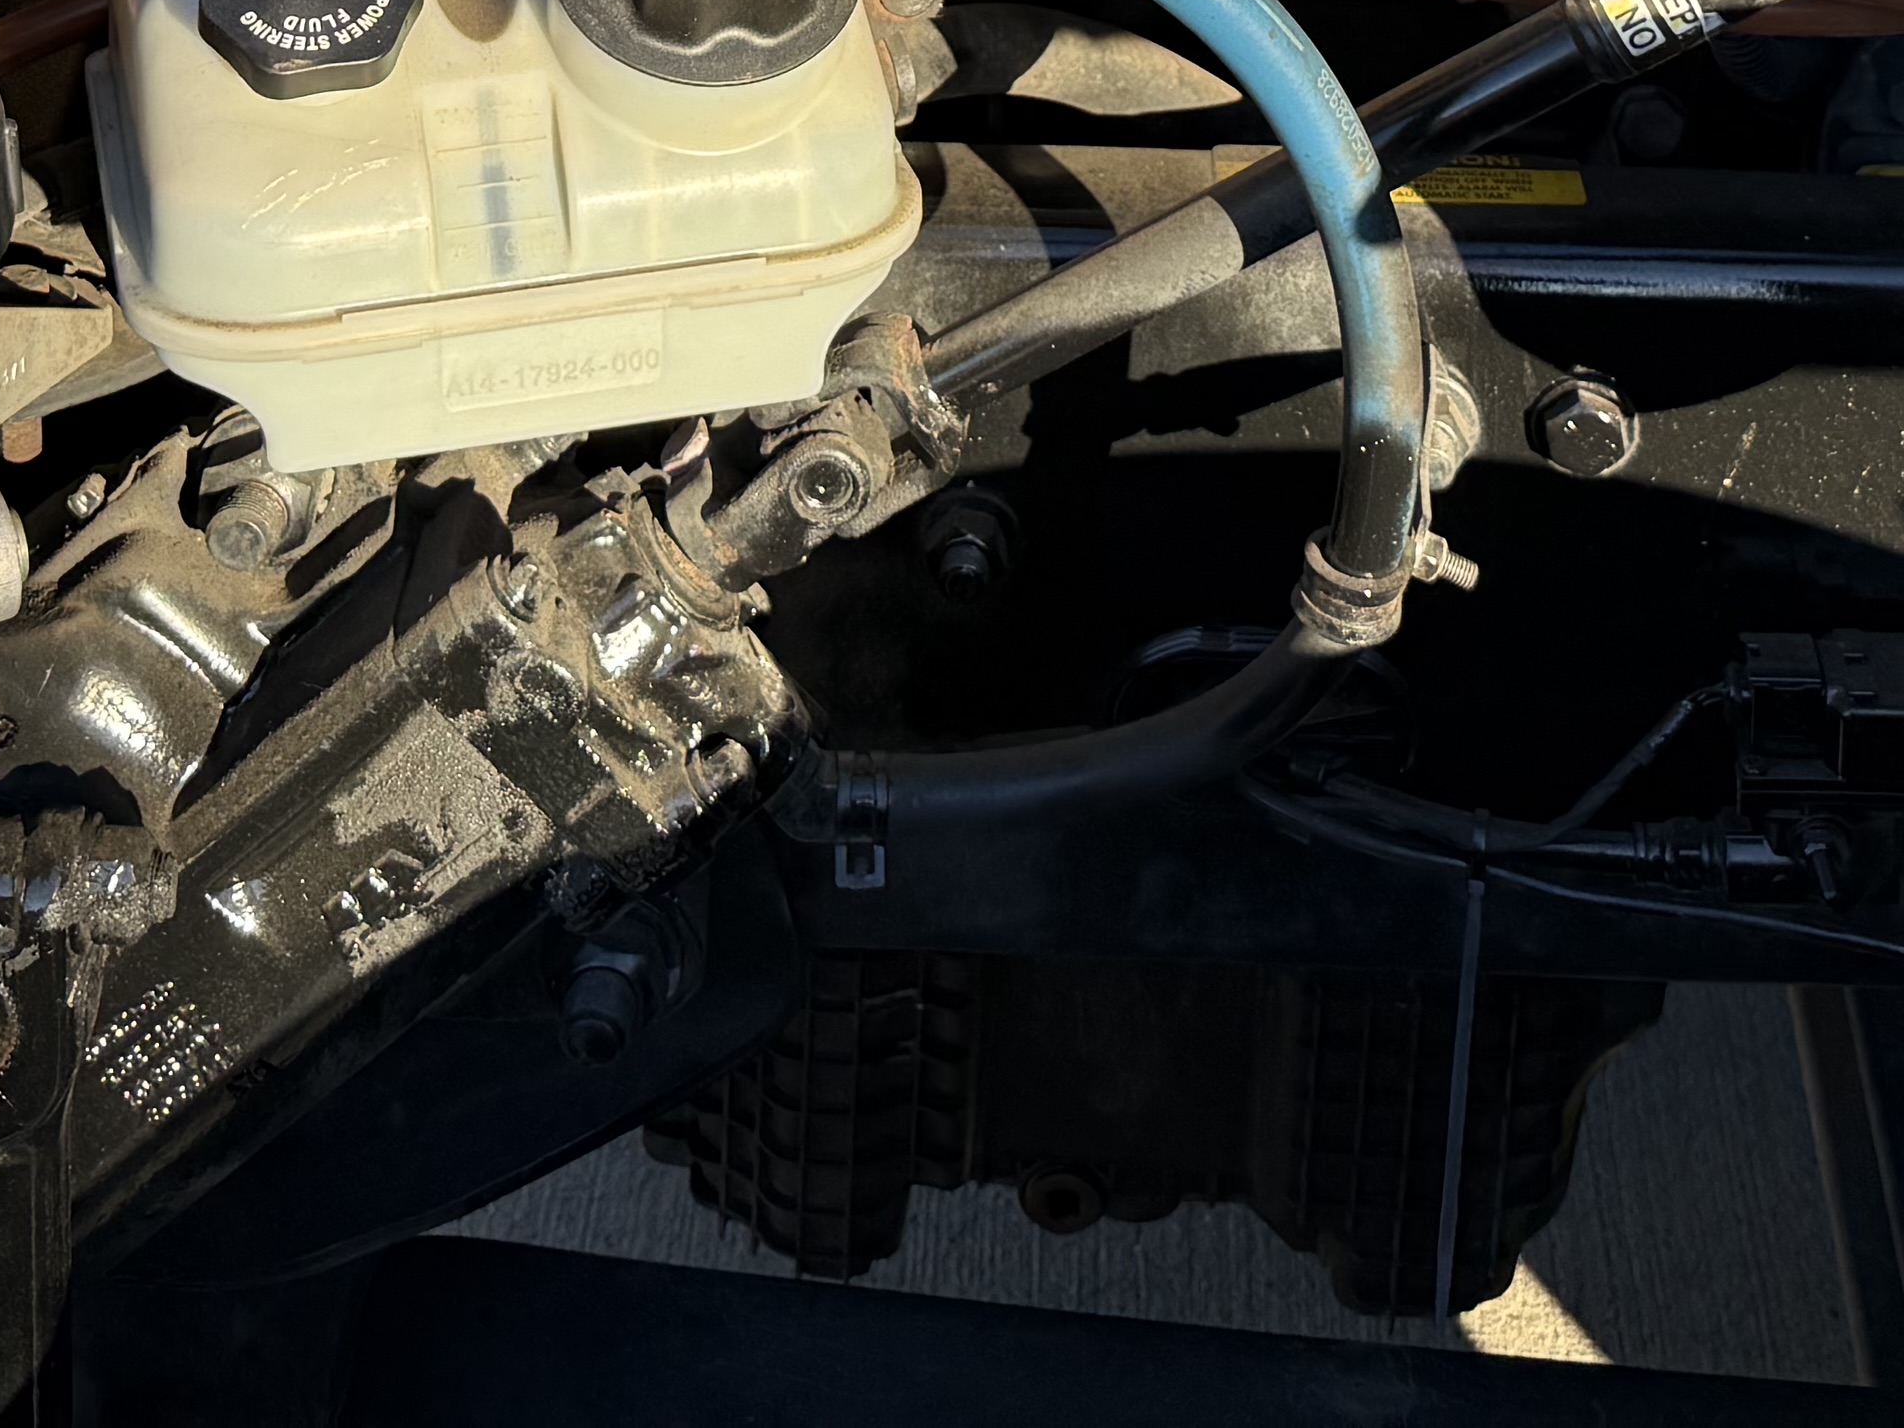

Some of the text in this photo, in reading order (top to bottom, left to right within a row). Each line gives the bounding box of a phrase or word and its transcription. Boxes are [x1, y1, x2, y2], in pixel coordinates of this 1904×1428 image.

[239, 9, 331, 51] STEERING
[282, 7, 352, 33] FLUID
[1614, 5, 1658, 50] NO
[445, 347, 661, 399] A14-17924-000
